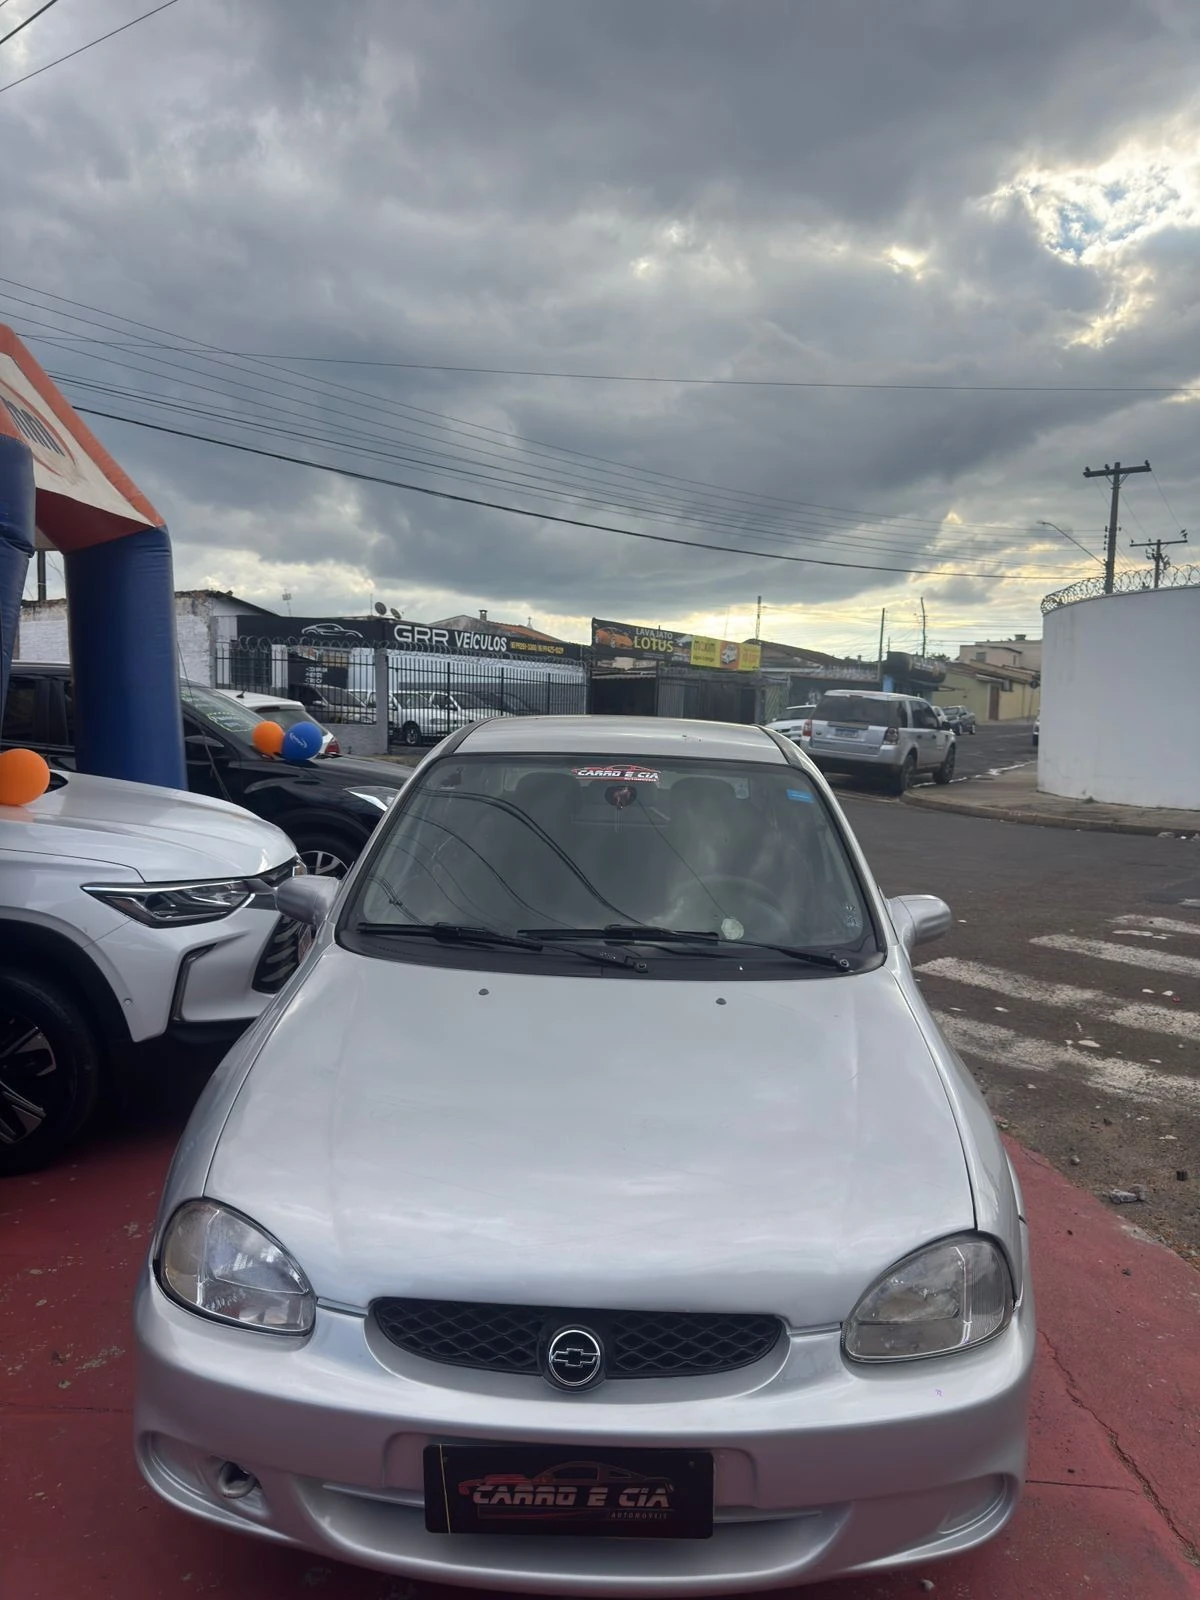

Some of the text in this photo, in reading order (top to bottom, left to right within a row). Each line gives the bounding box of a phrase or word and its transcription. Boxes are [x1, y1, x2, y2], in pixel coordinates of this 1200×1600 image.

[394, 625, 449, 646] GRR
[454, 631, 507, 652] VEÍCULOS
[634, 636, 673, 653] LOTUS
[577, 769, 621, 777] CARRO
[473, 1485, 578, 1505] CARRO
[587, 1487, 609, 1506] E
